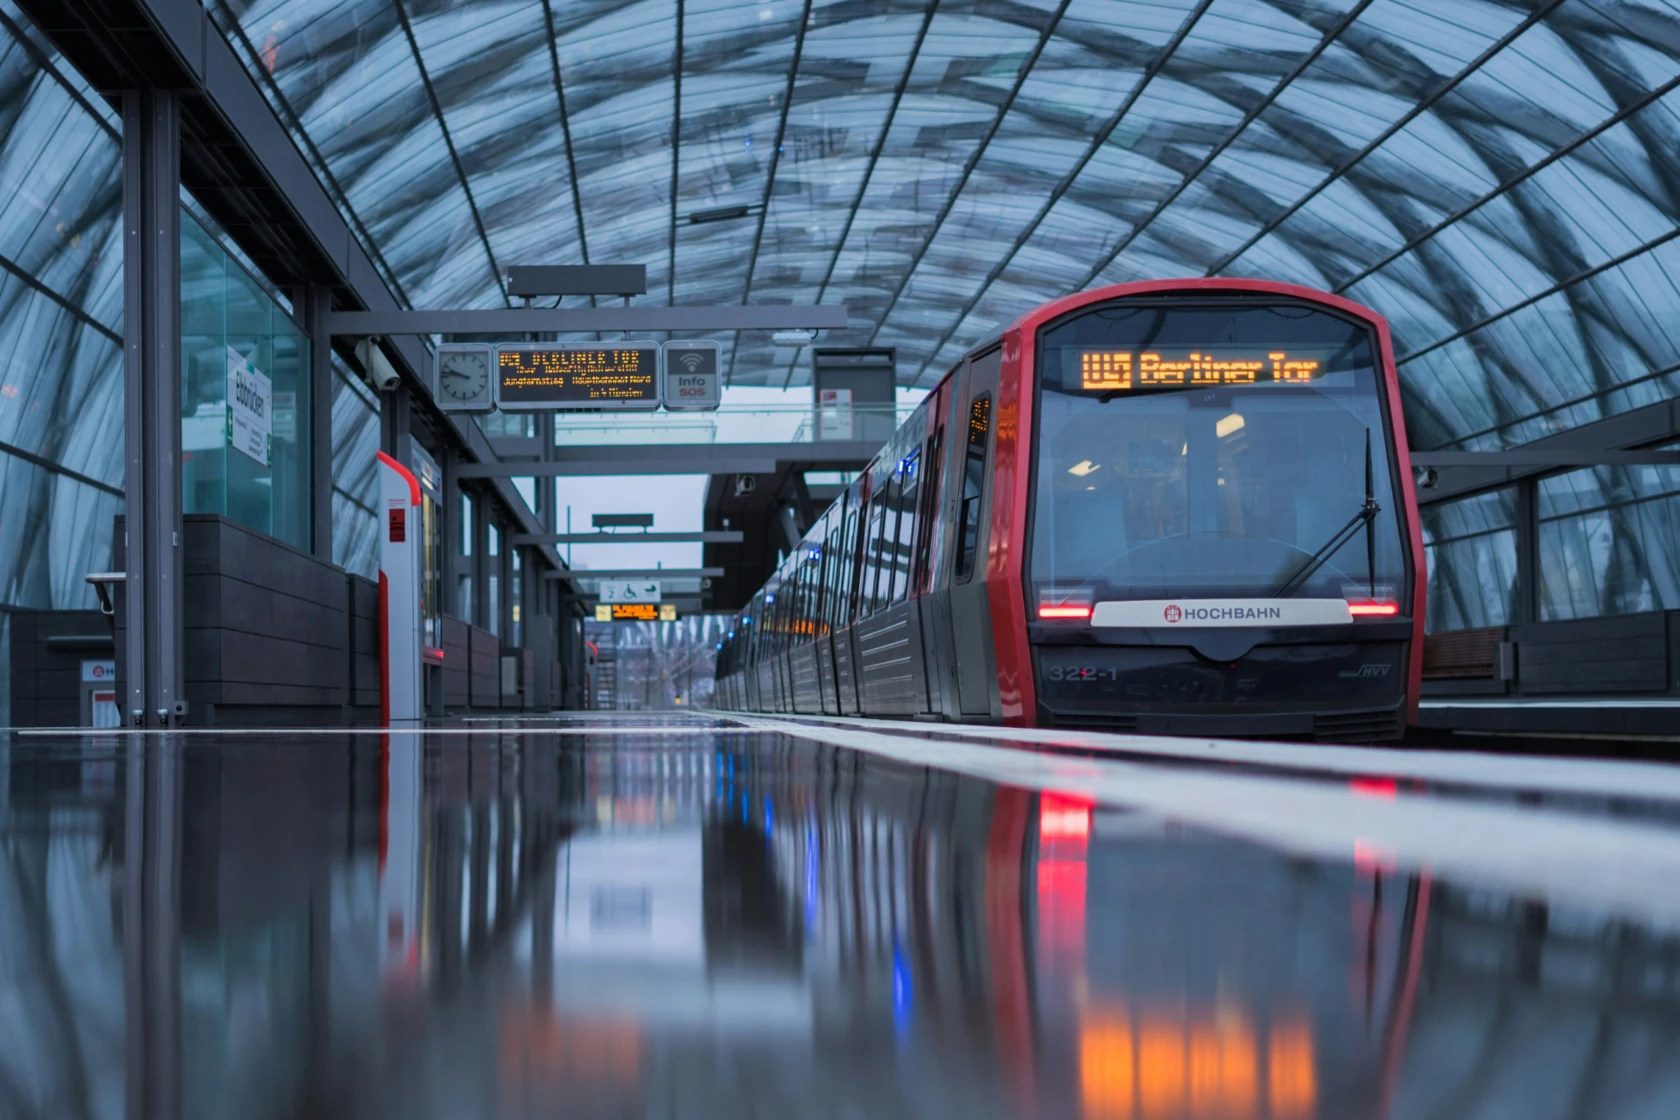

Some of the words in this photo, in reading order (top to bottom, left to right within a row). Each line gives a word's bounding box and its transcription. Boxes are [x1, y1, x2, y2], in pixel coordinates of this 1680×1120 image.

[612, 350, 639, 364] TOR
[1084, 353, 1129, 387] U4
[1140, 353, 1262, 384] Berliner
[1268, 352, 1318, 383] Tor
[629, 375, 651, 384] Nord
[679, 376, 705, 386] Info
[236, 370, 264, 419] Elbbrücken
[679, 387, 706, 397] SOS
[608, 590, 615, 599] 2
[1184, 607, 1281, 620] HOCHBAHN
[1049, 666, 1117, 681] 322-1
